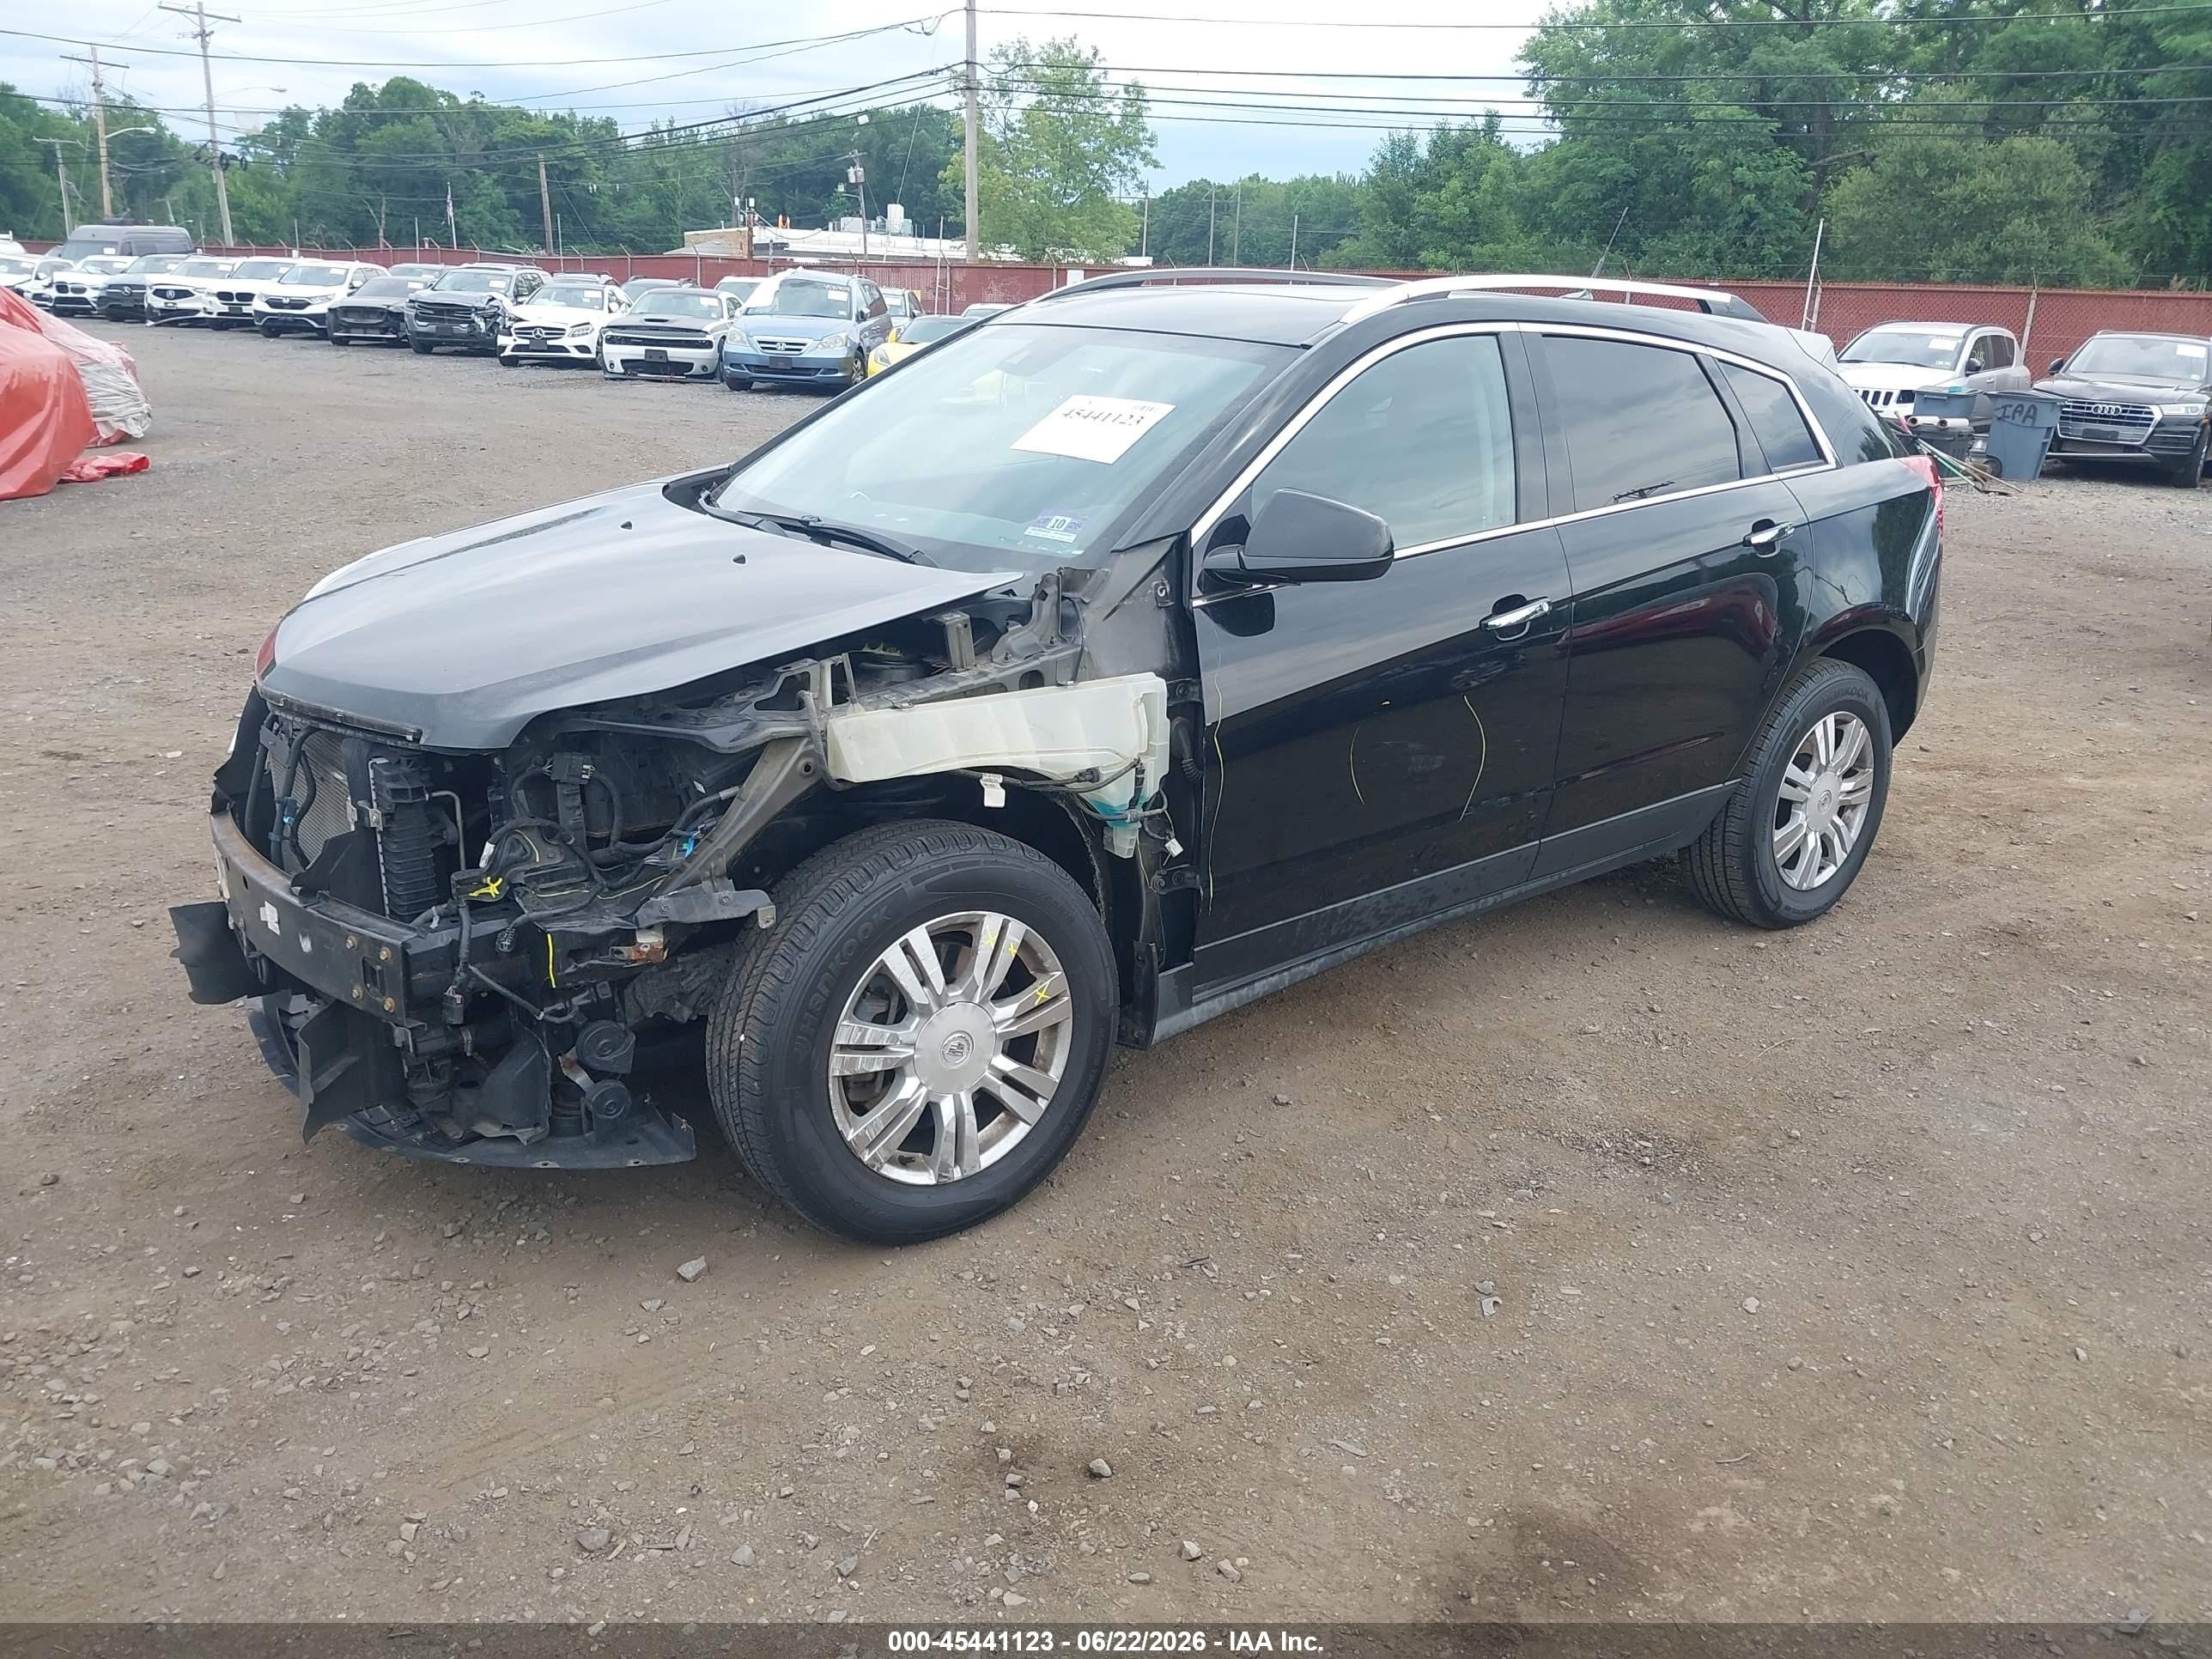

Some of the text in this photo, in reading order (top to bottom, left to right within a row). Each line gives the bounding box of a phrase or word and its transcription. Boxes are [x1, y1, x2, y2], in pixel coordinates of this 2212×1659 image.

[1061, 408, 1145, 426] 45441123
[1995, 404, 2038, 427] IAA
[1050, 519, 1066, 529] 10
